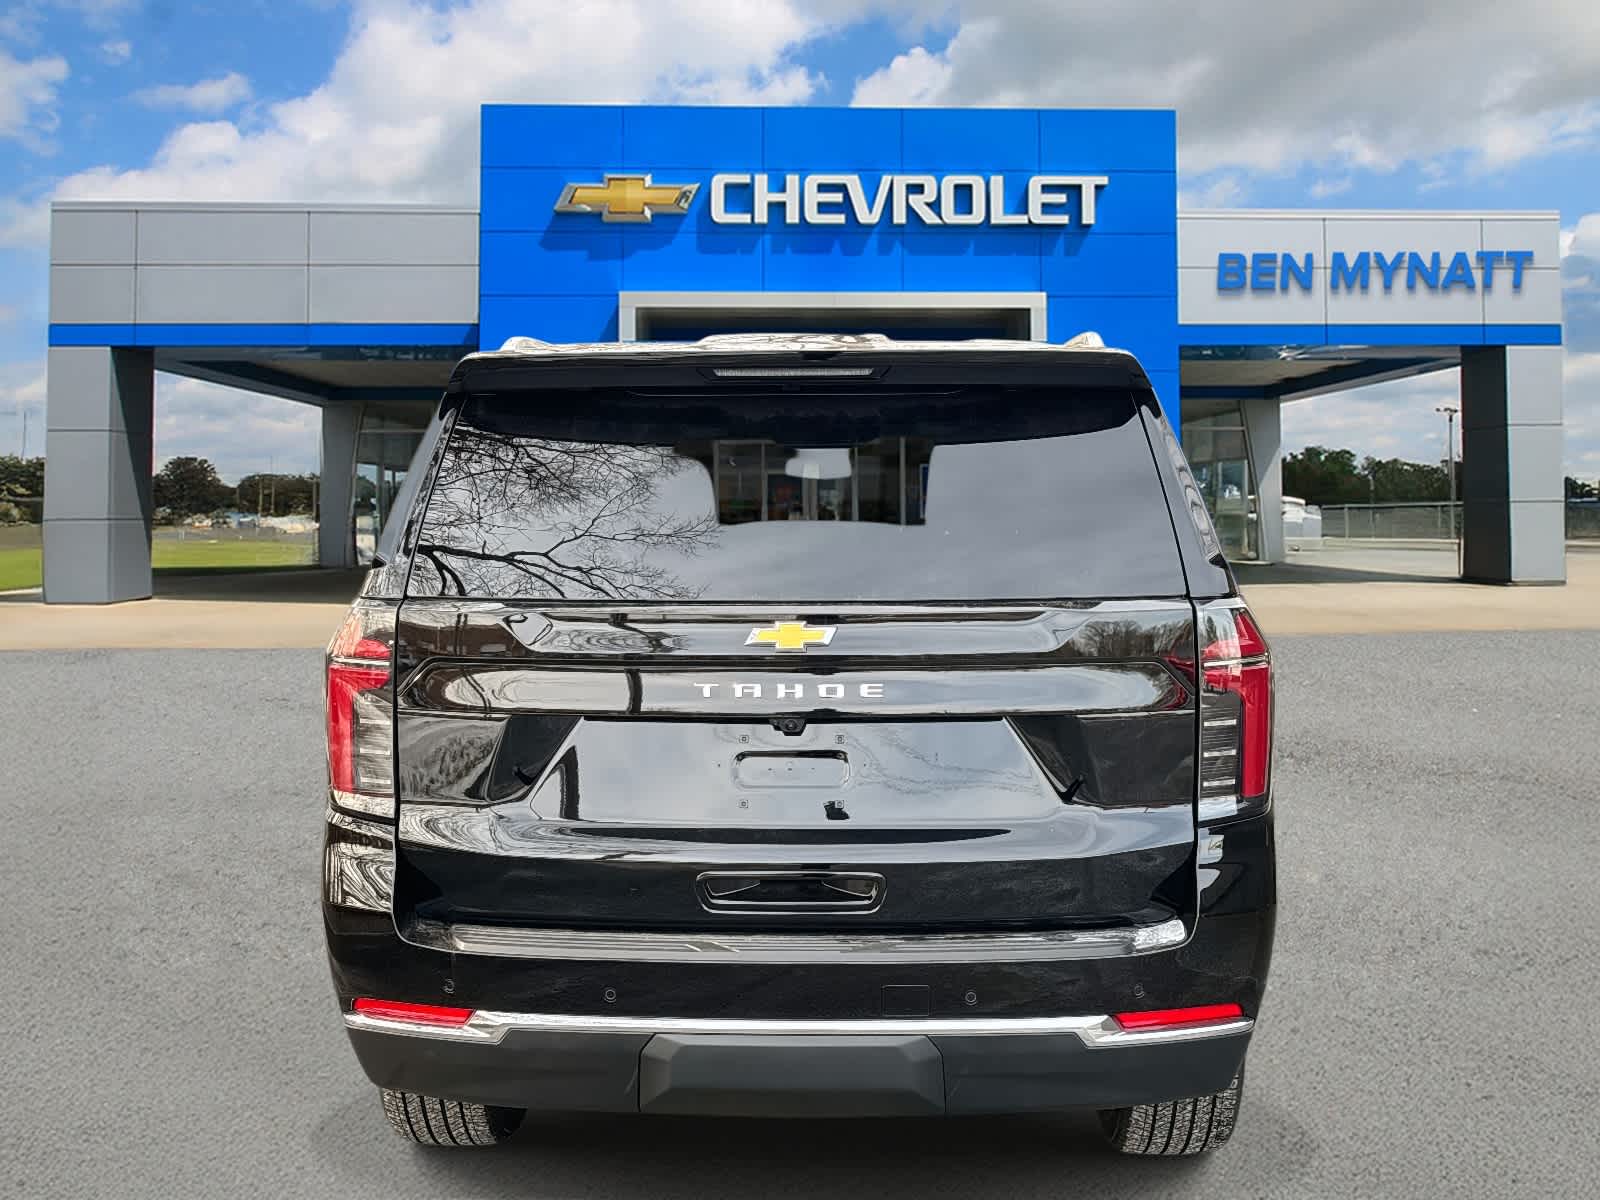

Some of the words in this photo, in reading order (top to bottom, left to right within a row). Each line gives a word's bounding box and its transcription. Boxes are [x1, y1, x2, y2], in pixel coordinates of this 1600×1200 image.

[710, 174, 1109, 226] CHEVROLET
[1217, 252, 1314, 291] BEN
[1330, 250, 1534, 290] MYNATT
[693, 682, 885, 699] TAHOE
